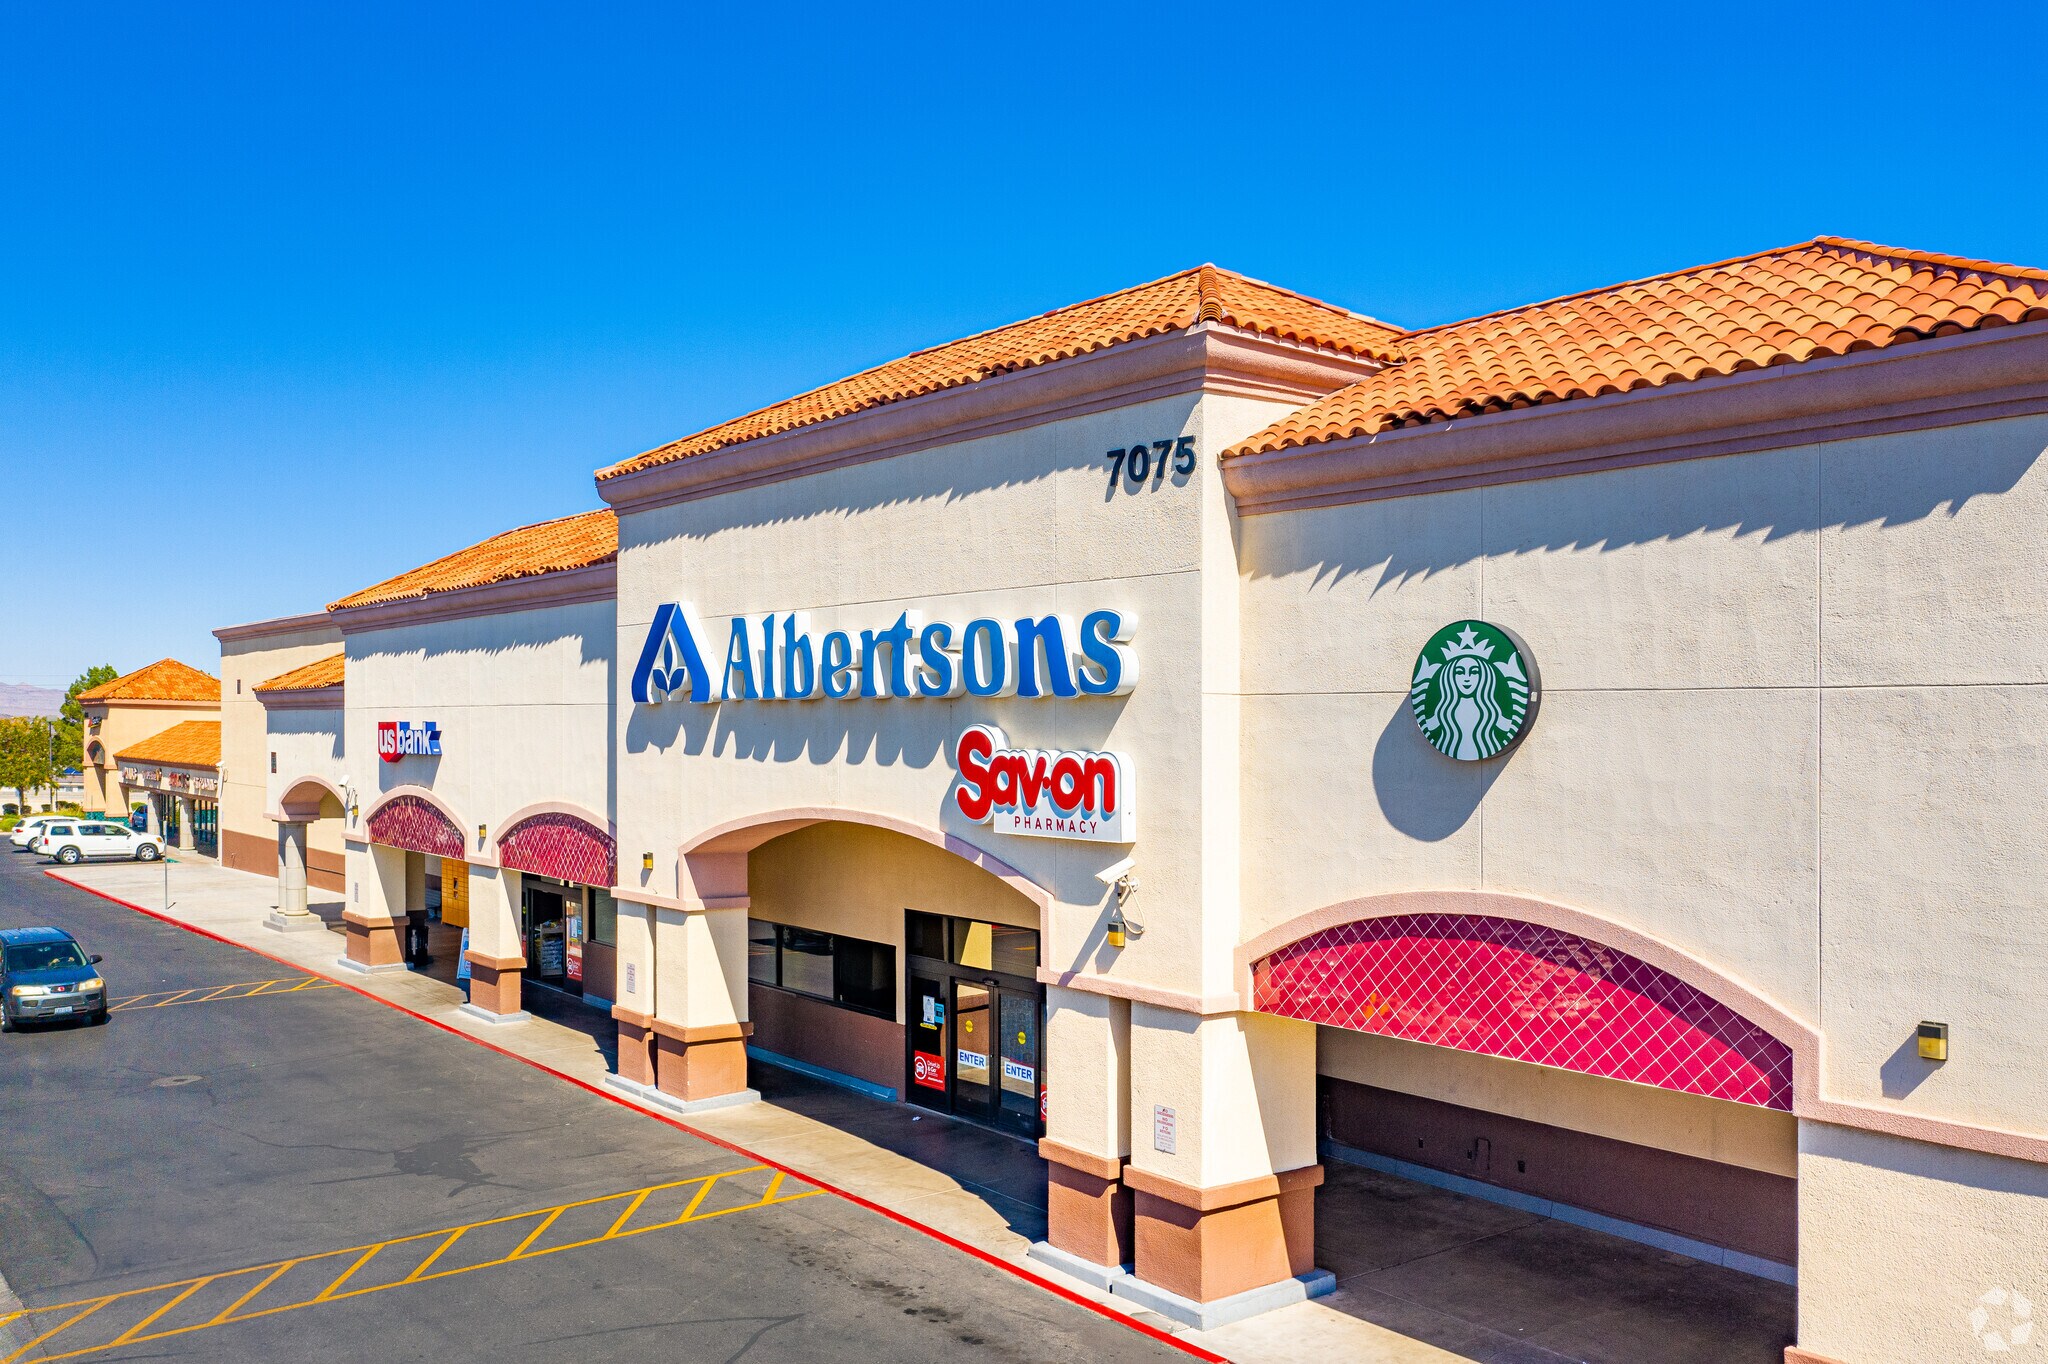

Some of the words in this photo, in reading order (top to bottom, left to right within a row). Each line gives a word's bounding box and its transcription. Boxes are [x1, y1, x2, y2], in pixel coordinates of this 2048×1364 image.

[1106, 435, 1196, 487] 7075
[721, 608, 1130, 698] Albertsons
[379, 729, 396, 754] us
[396, 721, 432, 755] bank
[1014, 815, 1098, 834] PHARMACY
[959, 1051, 985, 1067] ENTER
[1005, 1063, 1033, 1081] ENTER
